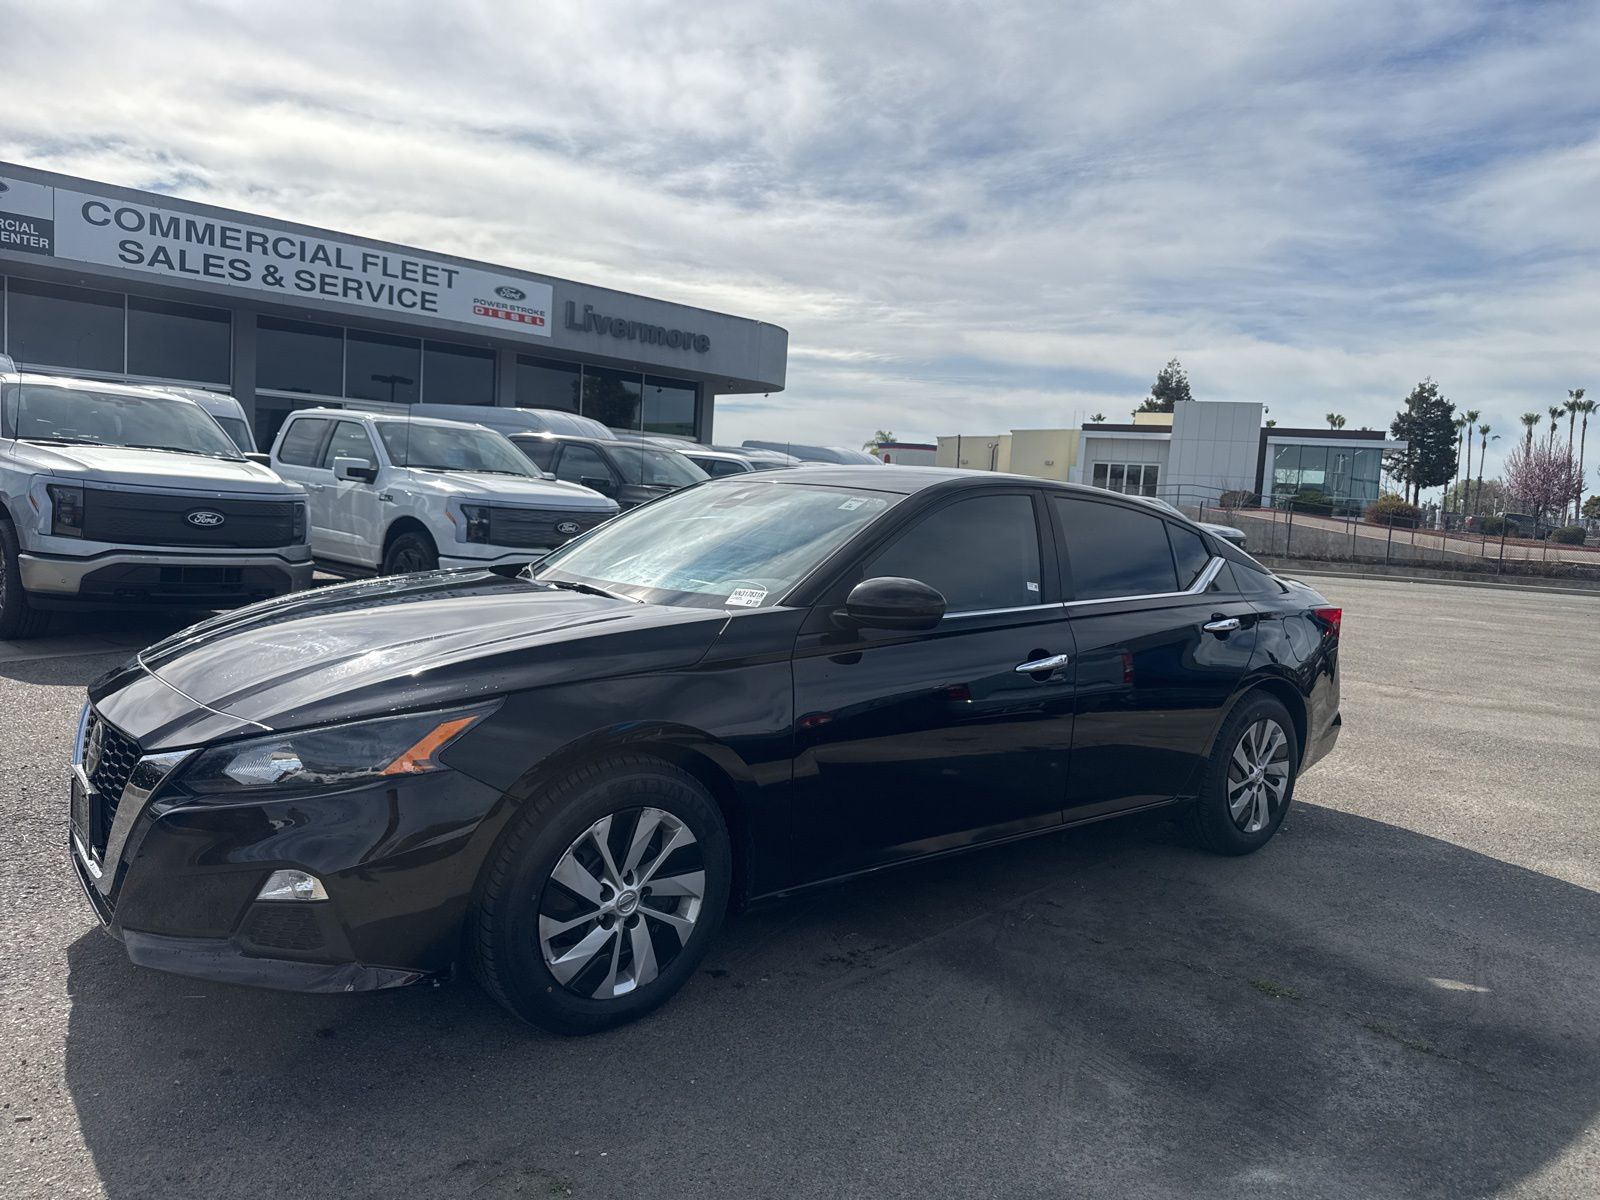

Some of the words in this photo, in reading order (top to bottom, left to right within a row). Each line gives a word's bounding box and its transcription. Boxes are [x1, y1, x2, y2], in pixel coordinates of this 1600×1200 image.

[81, 200, 353, 270] COMMERCIAL
[362, 252, 459, 289] FLEET
[118, 239, 252, 282] SALES
[261, 264, 286, 288] &
[294, 269, 438, 312] SERVICE
[498, 286, 523, 300] Ford
[473, 298, 508, 309] POWER
[509, 304, 545, 317] STROKE
[475, 307, 543, 325] DIESEL
[565, 300, 711, 352] Livermore
[192, 512, 219, 524] Ford
